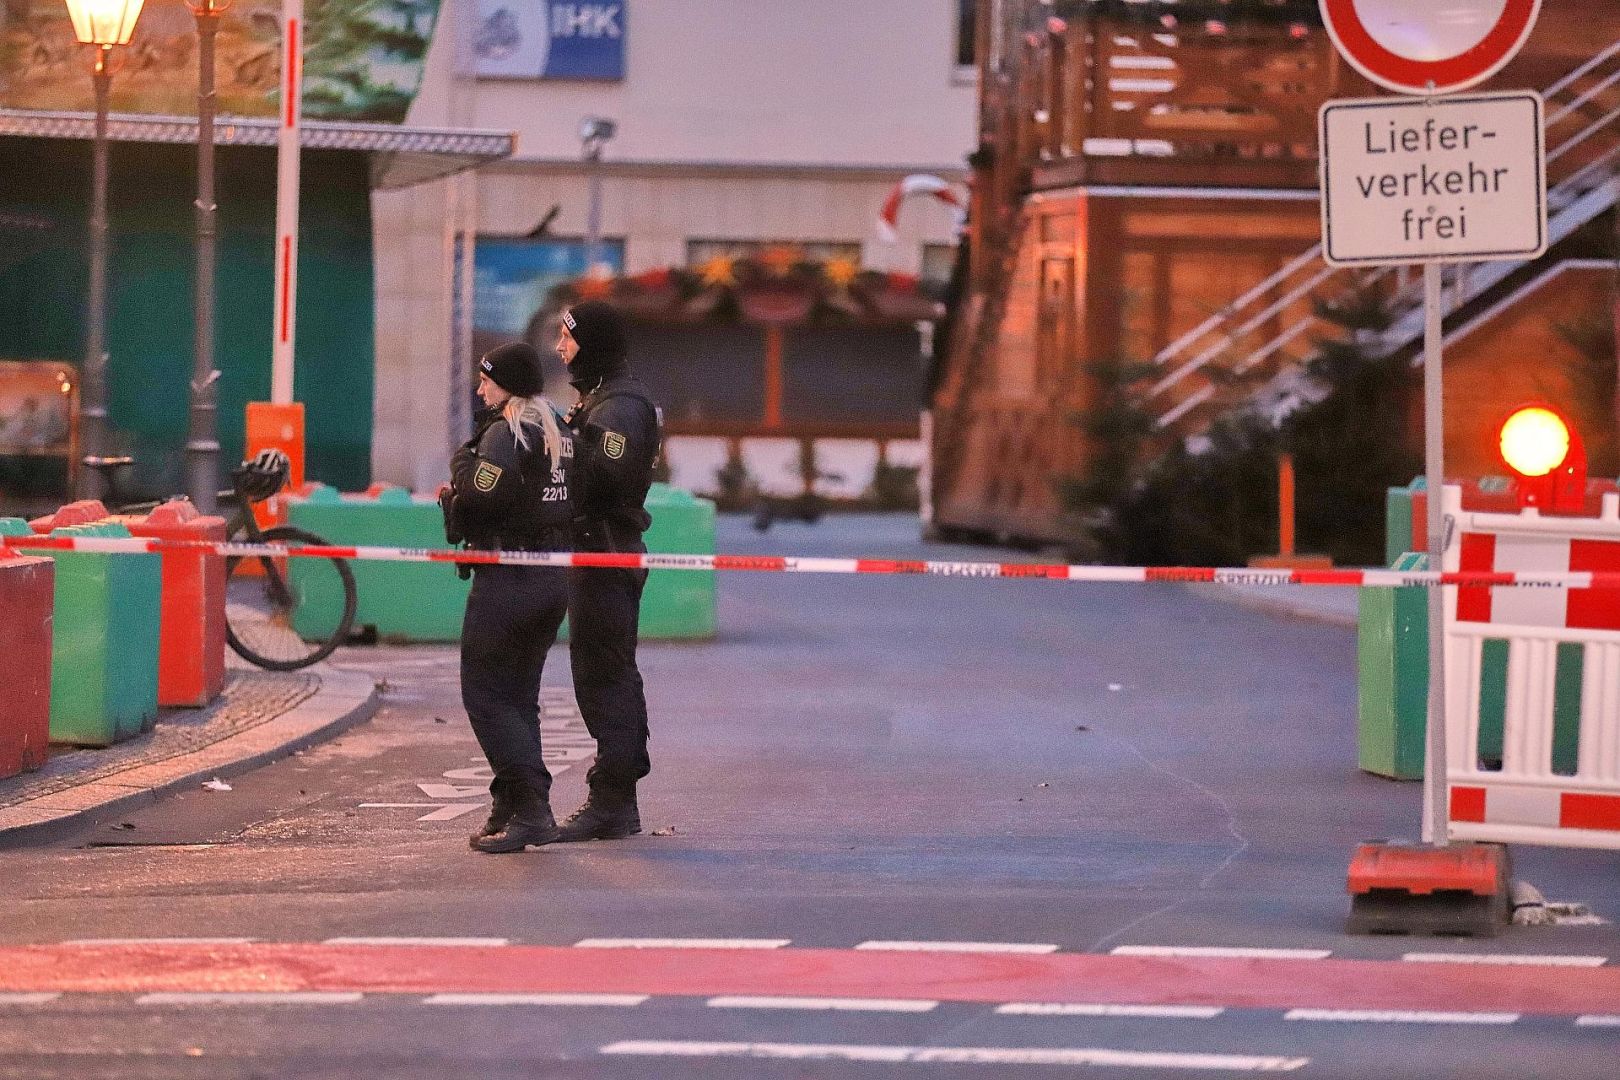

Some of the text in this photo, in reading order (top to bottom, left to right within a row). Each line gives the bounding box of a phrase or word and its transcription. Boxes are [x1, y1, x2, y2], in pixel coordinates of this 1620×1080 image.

[552, 3, 622, 38] IHK
[1364, 118, 1497, 154] Liefer-
[1356, 161, 1509, 198] verkehr
[1401, 206, 1467, 241] frei
[542, 486, 568, 501] 22/13
[551, 469, 565, 484] SN
